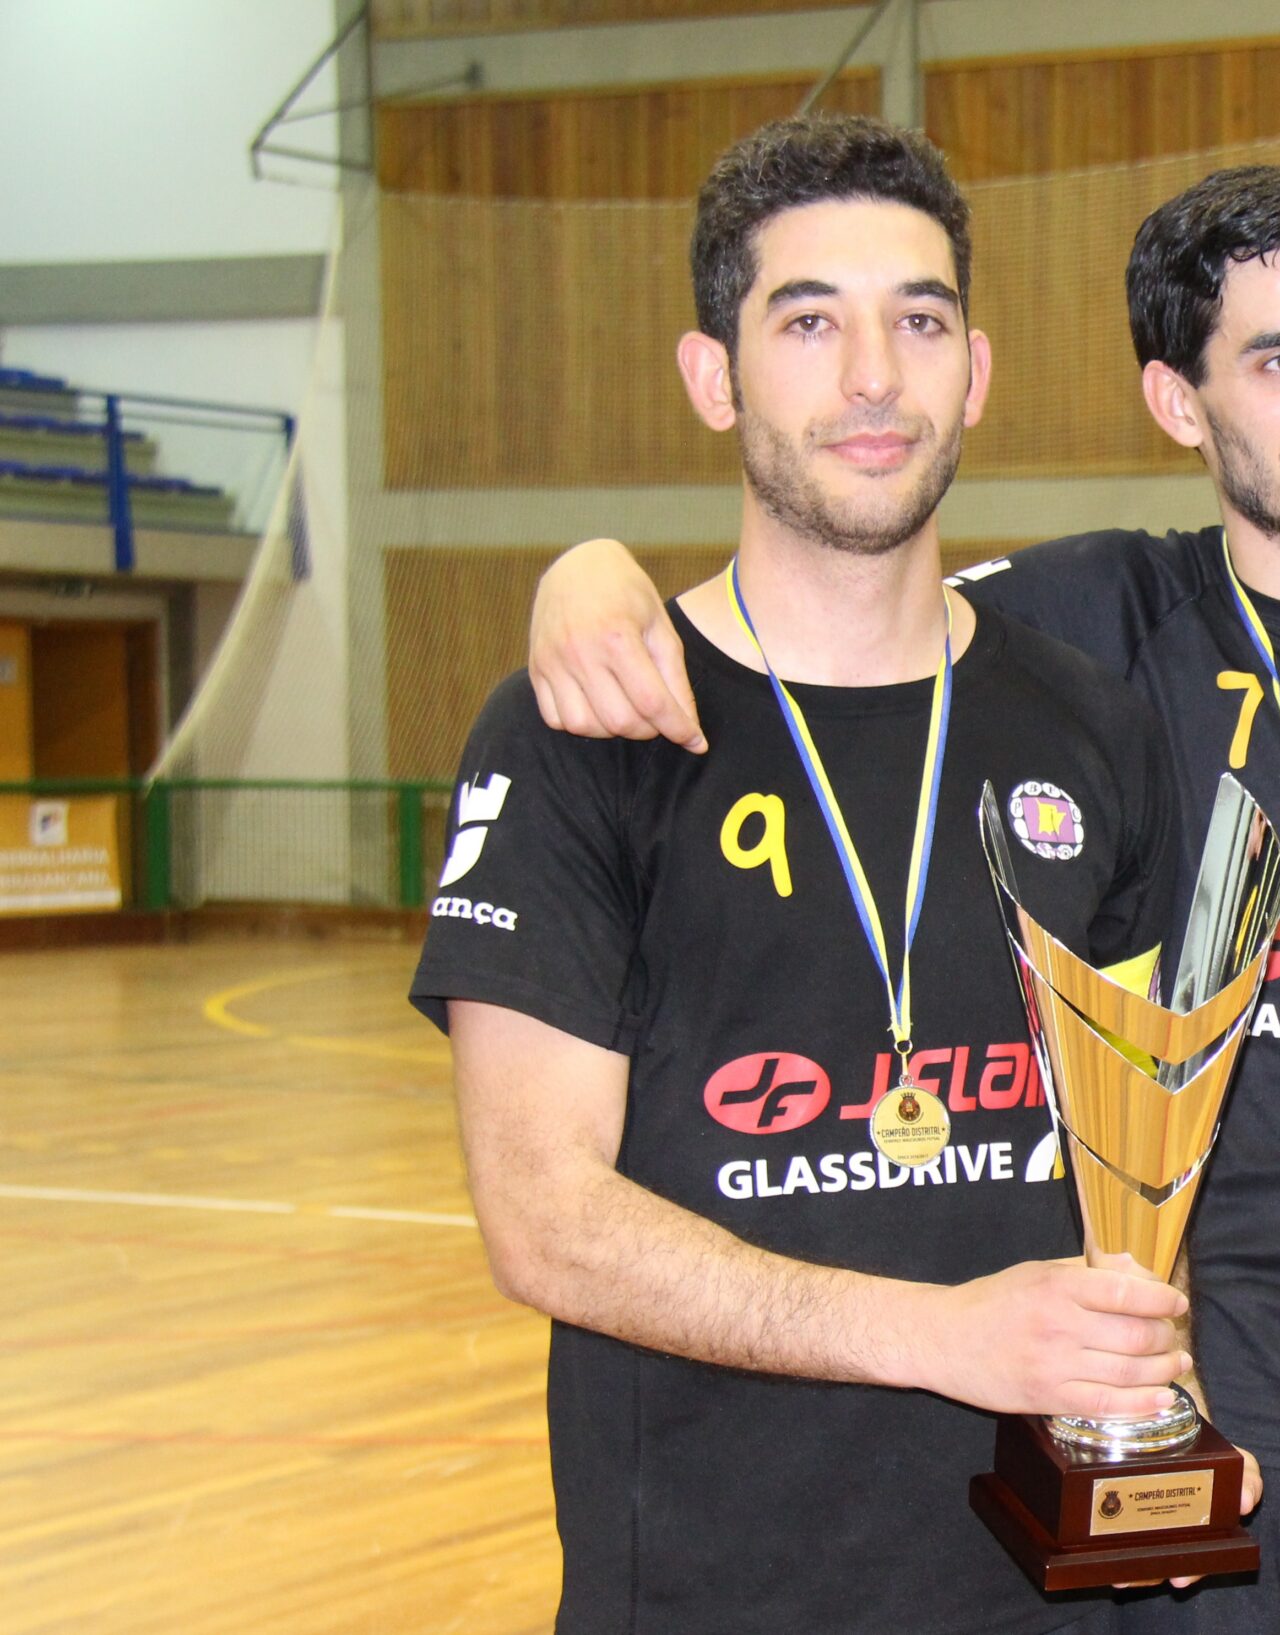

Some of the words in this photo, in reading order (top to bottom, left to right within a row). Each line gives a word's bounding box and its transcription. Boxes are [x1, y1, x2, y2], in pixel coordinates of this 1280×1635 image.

[1216, 671, 1264, 769] 7
[717, 1141, 1014, 1200] GLASSDRIVE
[1166, 1487, 1196, 1497] DISTRITAL
